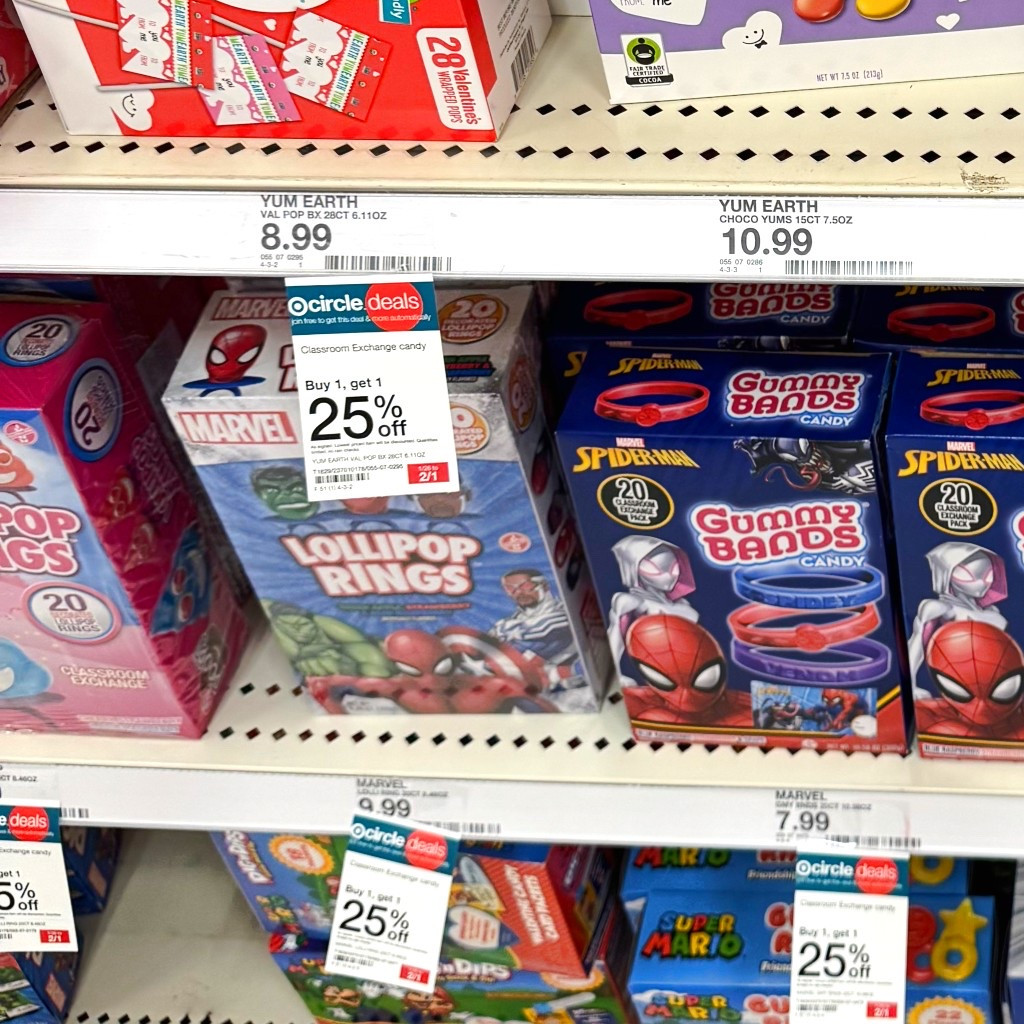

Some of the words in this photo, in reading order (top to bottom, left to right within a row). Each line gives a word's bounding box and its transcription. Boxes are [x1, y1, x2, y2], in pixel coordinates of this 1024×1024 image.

[425, 36, 467, 69] 28
[452, 67, 480, 126] Valentine's
[437, 71, 459, 106] WRAPPED
[451, 105, 463, 124] POPS
[260, 195, 298, 209] YUM
[303, 195, 359, 209] EARTH
[719, 199, 757, 213] YUM
[762, 199, 819, 213] EARTH
[260, 210, 281, 219] VAL
[283, 210, 305, 220] POP
[307, 211, 322, 220] BX
[323, 211, 350, 220] 28CT
[352, 211, 388, 220] 6.11OZ
[719, 215, 759, 224] CHOCO
[761, 215, 793, 224] YUMS
[795, 215, 821, 224] 15CT
[823, 215, 853, 225] 7.5OZ
[260, 223, 332, 251] 8.99
[722, 227, 813, 255] 10.99
[308, 294, 364, 313] circle
[367, 292, 420, 311] deals
[180, 411, 295, 444] MARVEL
[378, 419, 407, 437] off
[940, 483, 972, 506] 20
[936, 504, 979, 514] CLASSROOM
[940, 512, 976, 522] EXCHANGE
[950, 520, 968, 528] PACK
[284, 533, 480, 564] LOLLIPOP
[314, 563, 471, 596] RINGS
[775, 789, 828, 801] MARVEL
[775, 810, 830, 832] 7.99
[660, 910, 736, 932] SUPER
[642, 931, 744, 960] MARIO
